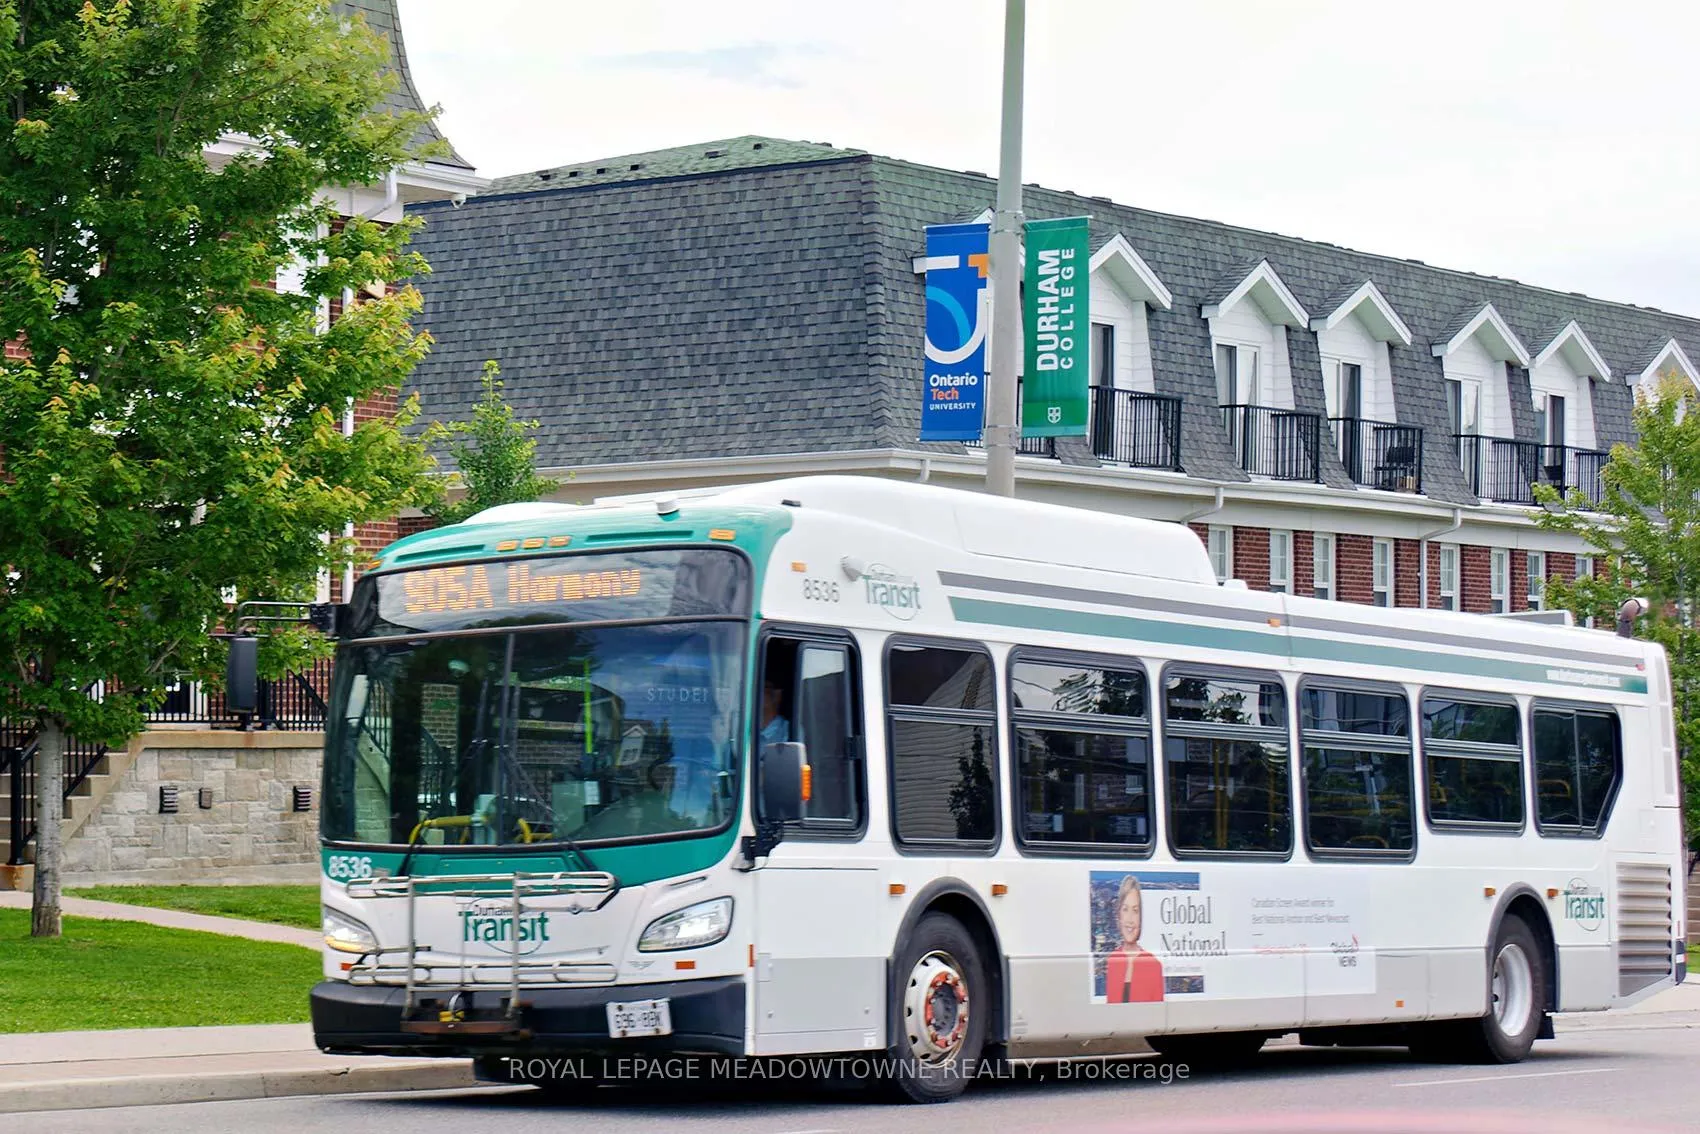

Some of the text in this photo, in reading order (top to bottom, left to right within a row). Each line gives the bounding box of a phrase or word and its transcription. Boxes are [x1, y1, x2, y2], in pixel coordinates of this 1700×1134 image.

[1036, 249, 1061, 371] DURHAM
[1060, 247, 1075, 370] COLLEGE
[929, 372, 978, 387] Ontario
[930, 387, 959, 400] Tech
[929, 402, 977, 411] UNIVERSITY
[404, 564, 641, 613] 905A Harmony
[862, 573, 922, 609] Transit
[328, 855, 373, 879] 8536
[1160, 896, 1212, 925] Global
[1563, 890, 1605, 919] Transit
[463, 911, 550, 941] Transit
[1160, 930, 1229, 957] National
